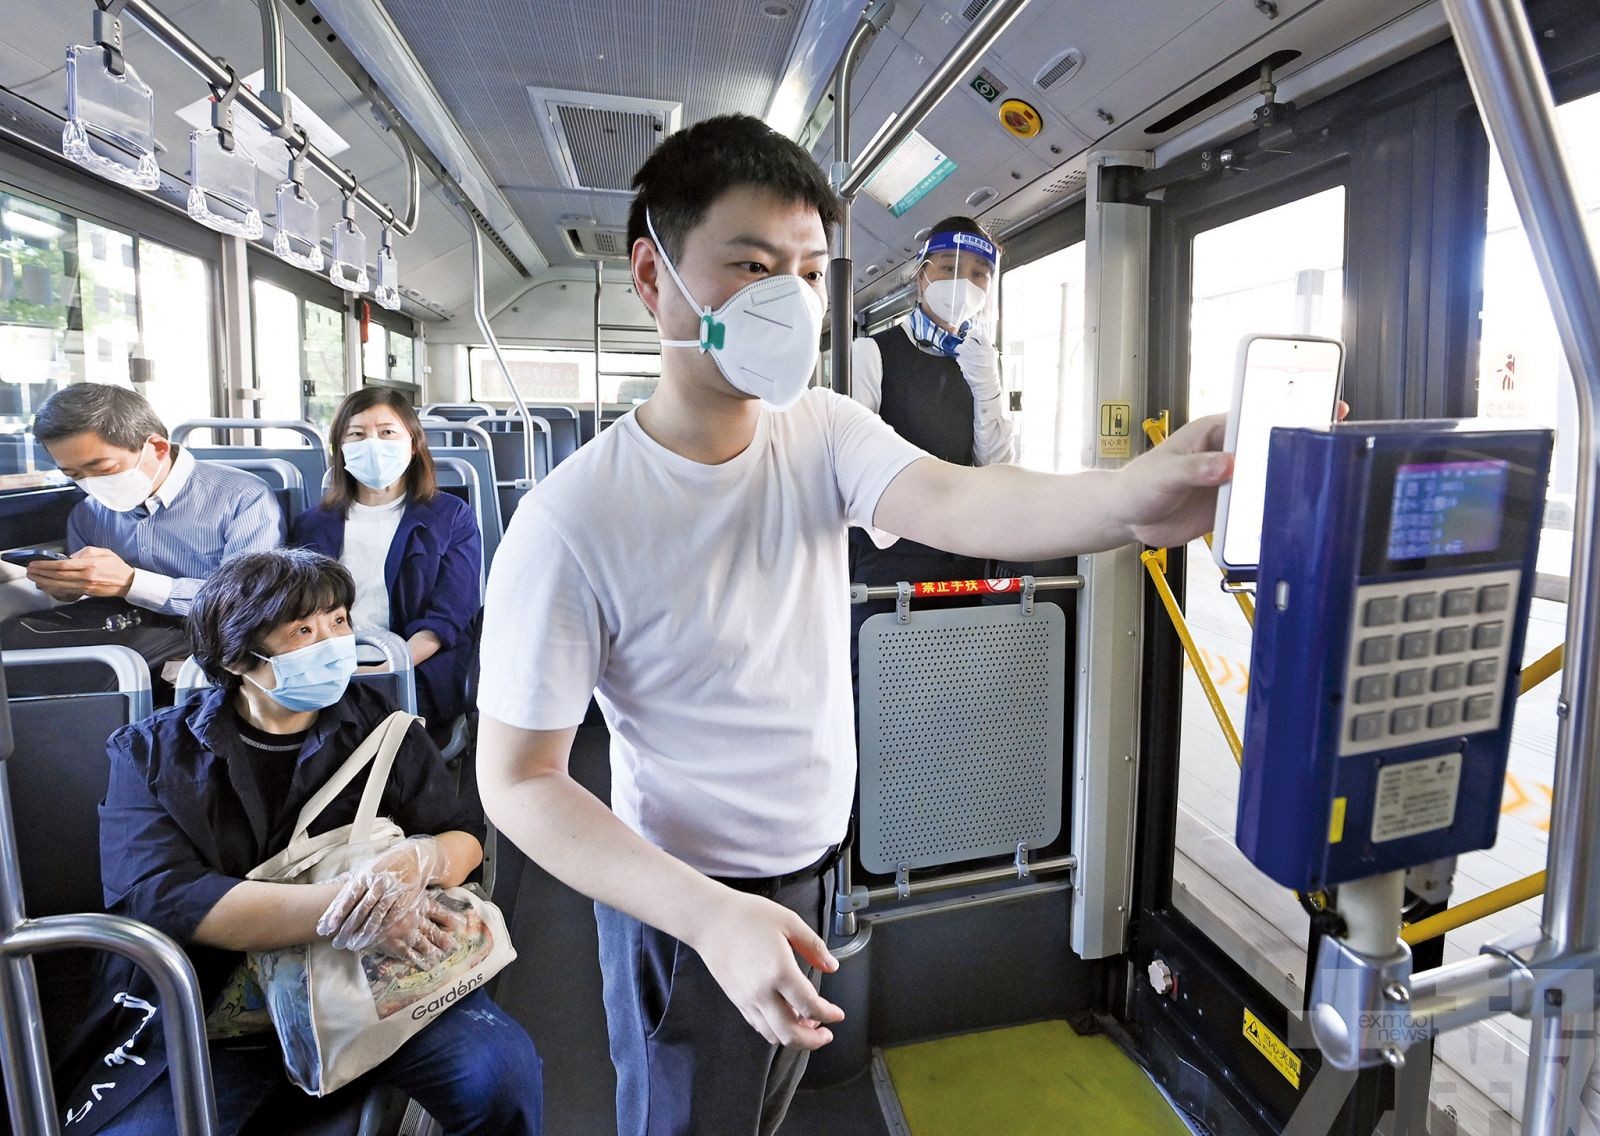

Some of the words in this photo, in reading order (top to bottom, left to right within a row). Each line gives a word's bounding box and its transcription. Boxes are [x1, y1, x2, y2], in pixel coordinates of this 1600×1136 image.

[921, 580, 979, 593] 禁止手扶
[411, 973, 483, 1020] Gardéns
